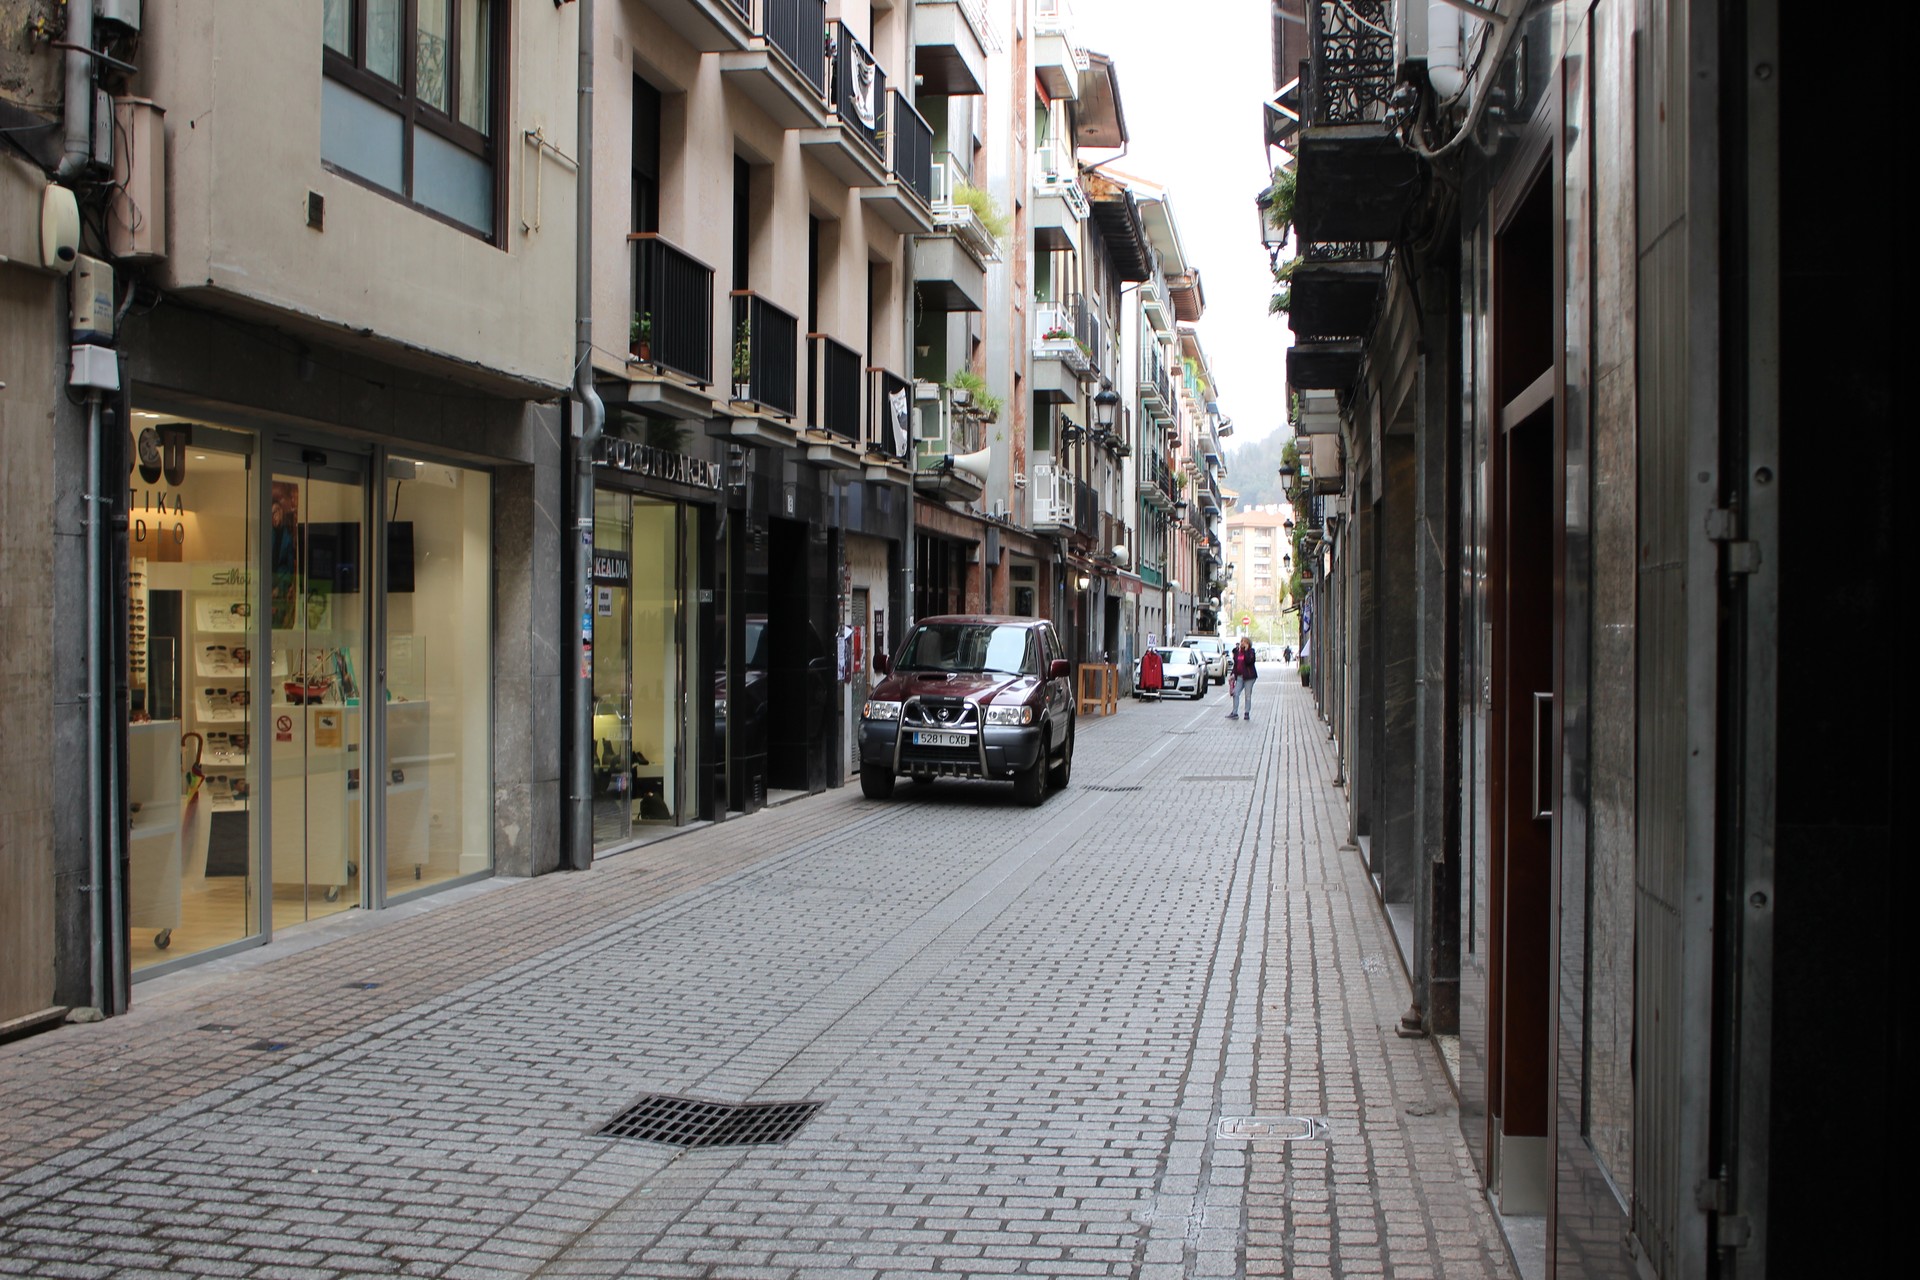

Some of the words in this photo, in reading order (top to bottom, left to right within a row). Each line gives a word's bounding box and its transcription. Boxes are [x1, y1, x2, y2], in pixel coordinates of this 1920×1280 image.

[594, 556, 628, 579] KEALDIA
[921, 734, 943, 743] 5281
[949, 735, 967, 745] CXB
